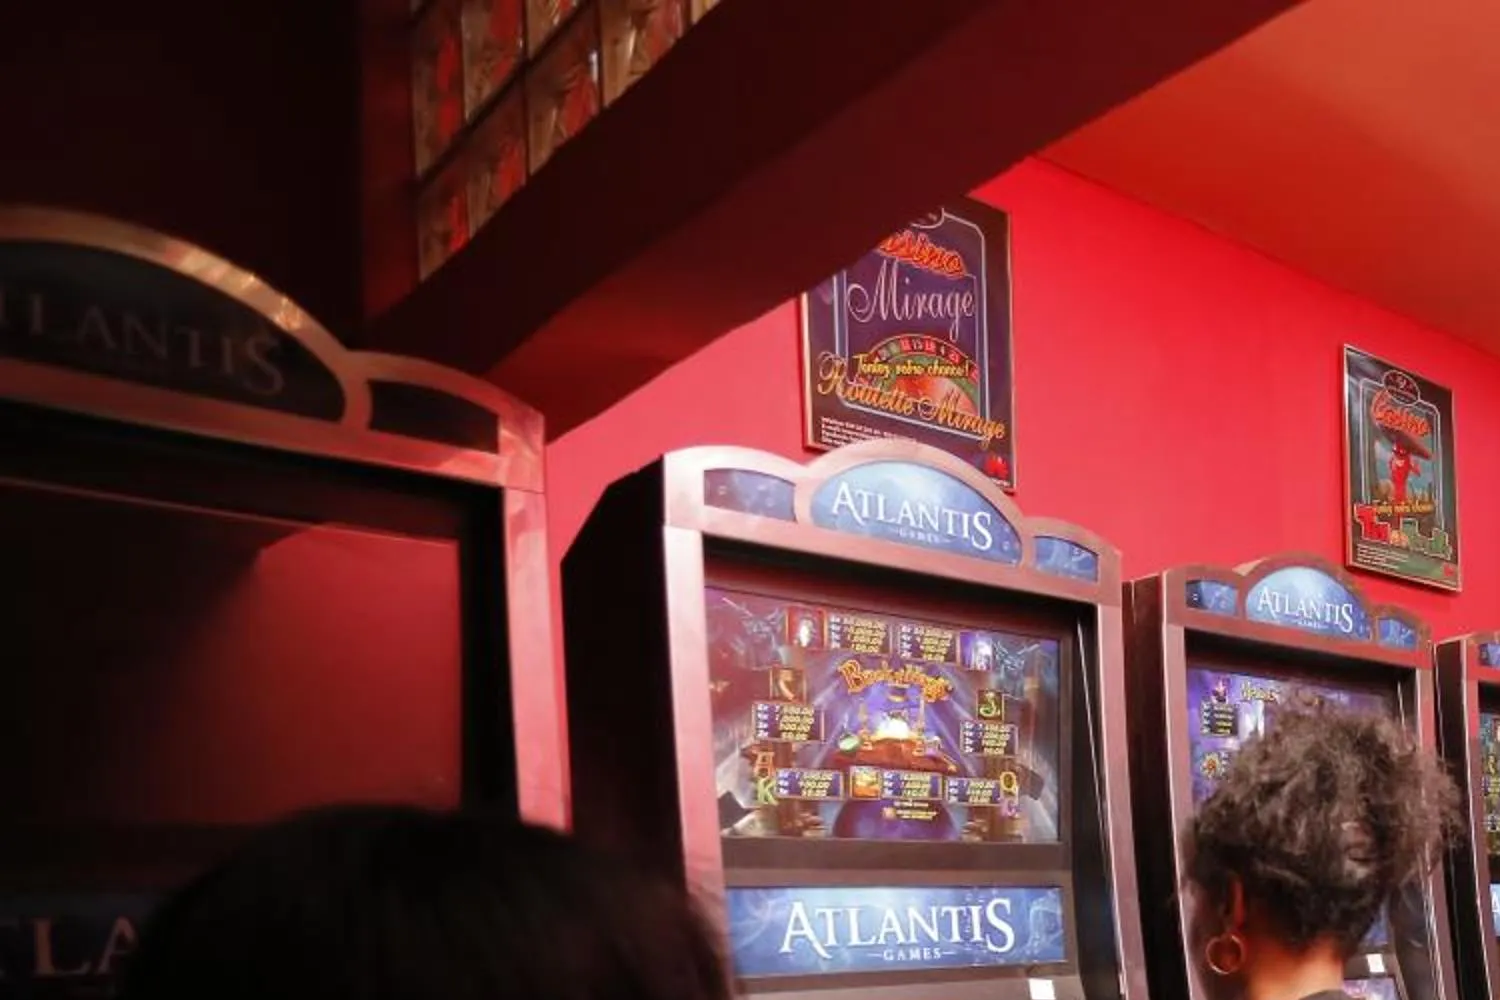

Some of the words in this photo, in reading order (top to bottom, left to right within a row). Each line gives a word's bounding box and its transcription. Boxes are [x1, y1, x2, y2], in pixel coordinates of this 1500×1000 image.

[847, 259, 975, 342] Mirage
[831, 480, 993, 551] ATLANTIS
[1257, 586, 1353, 634] ATLANTIS
[779, 898, 1016, 960] ATLANTIS
[883, 948, 942, 961] GAMES
